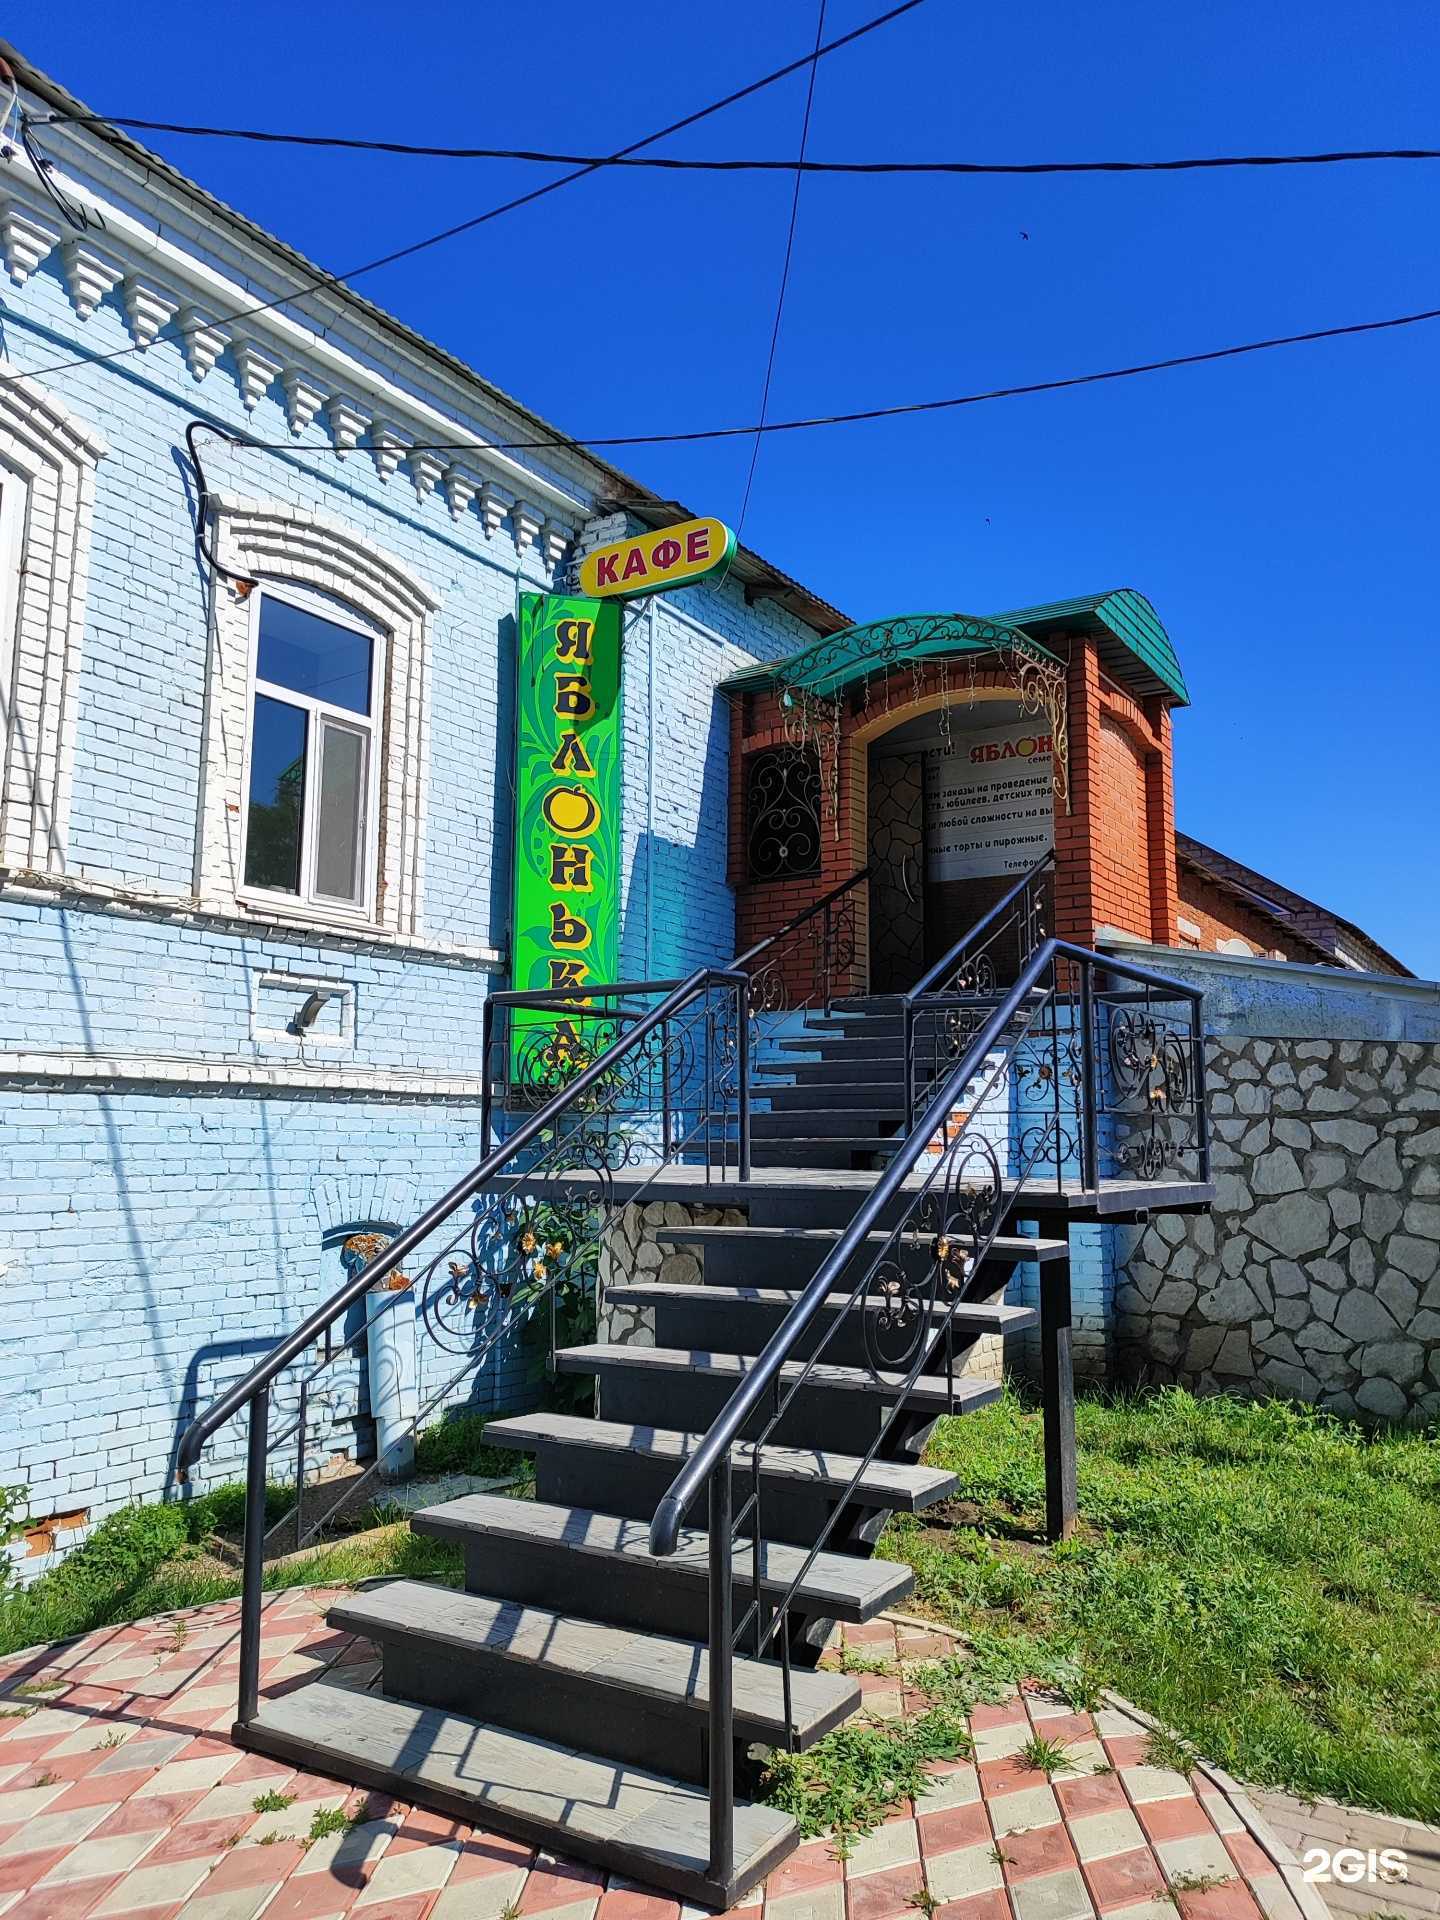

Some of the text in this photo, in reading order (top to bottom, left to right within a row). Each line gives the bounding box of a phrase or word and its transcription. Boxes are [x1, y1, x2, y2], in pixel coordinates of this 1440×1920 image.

[596, 526, 711, 588] КАФЕ
[943, 787, 975, 798] заказы
[977, 784, 989, 793] на
[990, 776, 1049, 793] проведение
[993, 790, 1033, 804] детских
[938, 815, 969, 830] любой
[970, 810, 1023, 825] сложности
[1025, 808, 1037, 818] на
[542, 617, 600, 1069] ЯБЛОНЬКА
[953, 841, 983, 854] торты
[986, 840, 991, 848] и
[993, 832, 1048, 849] пирожные.
